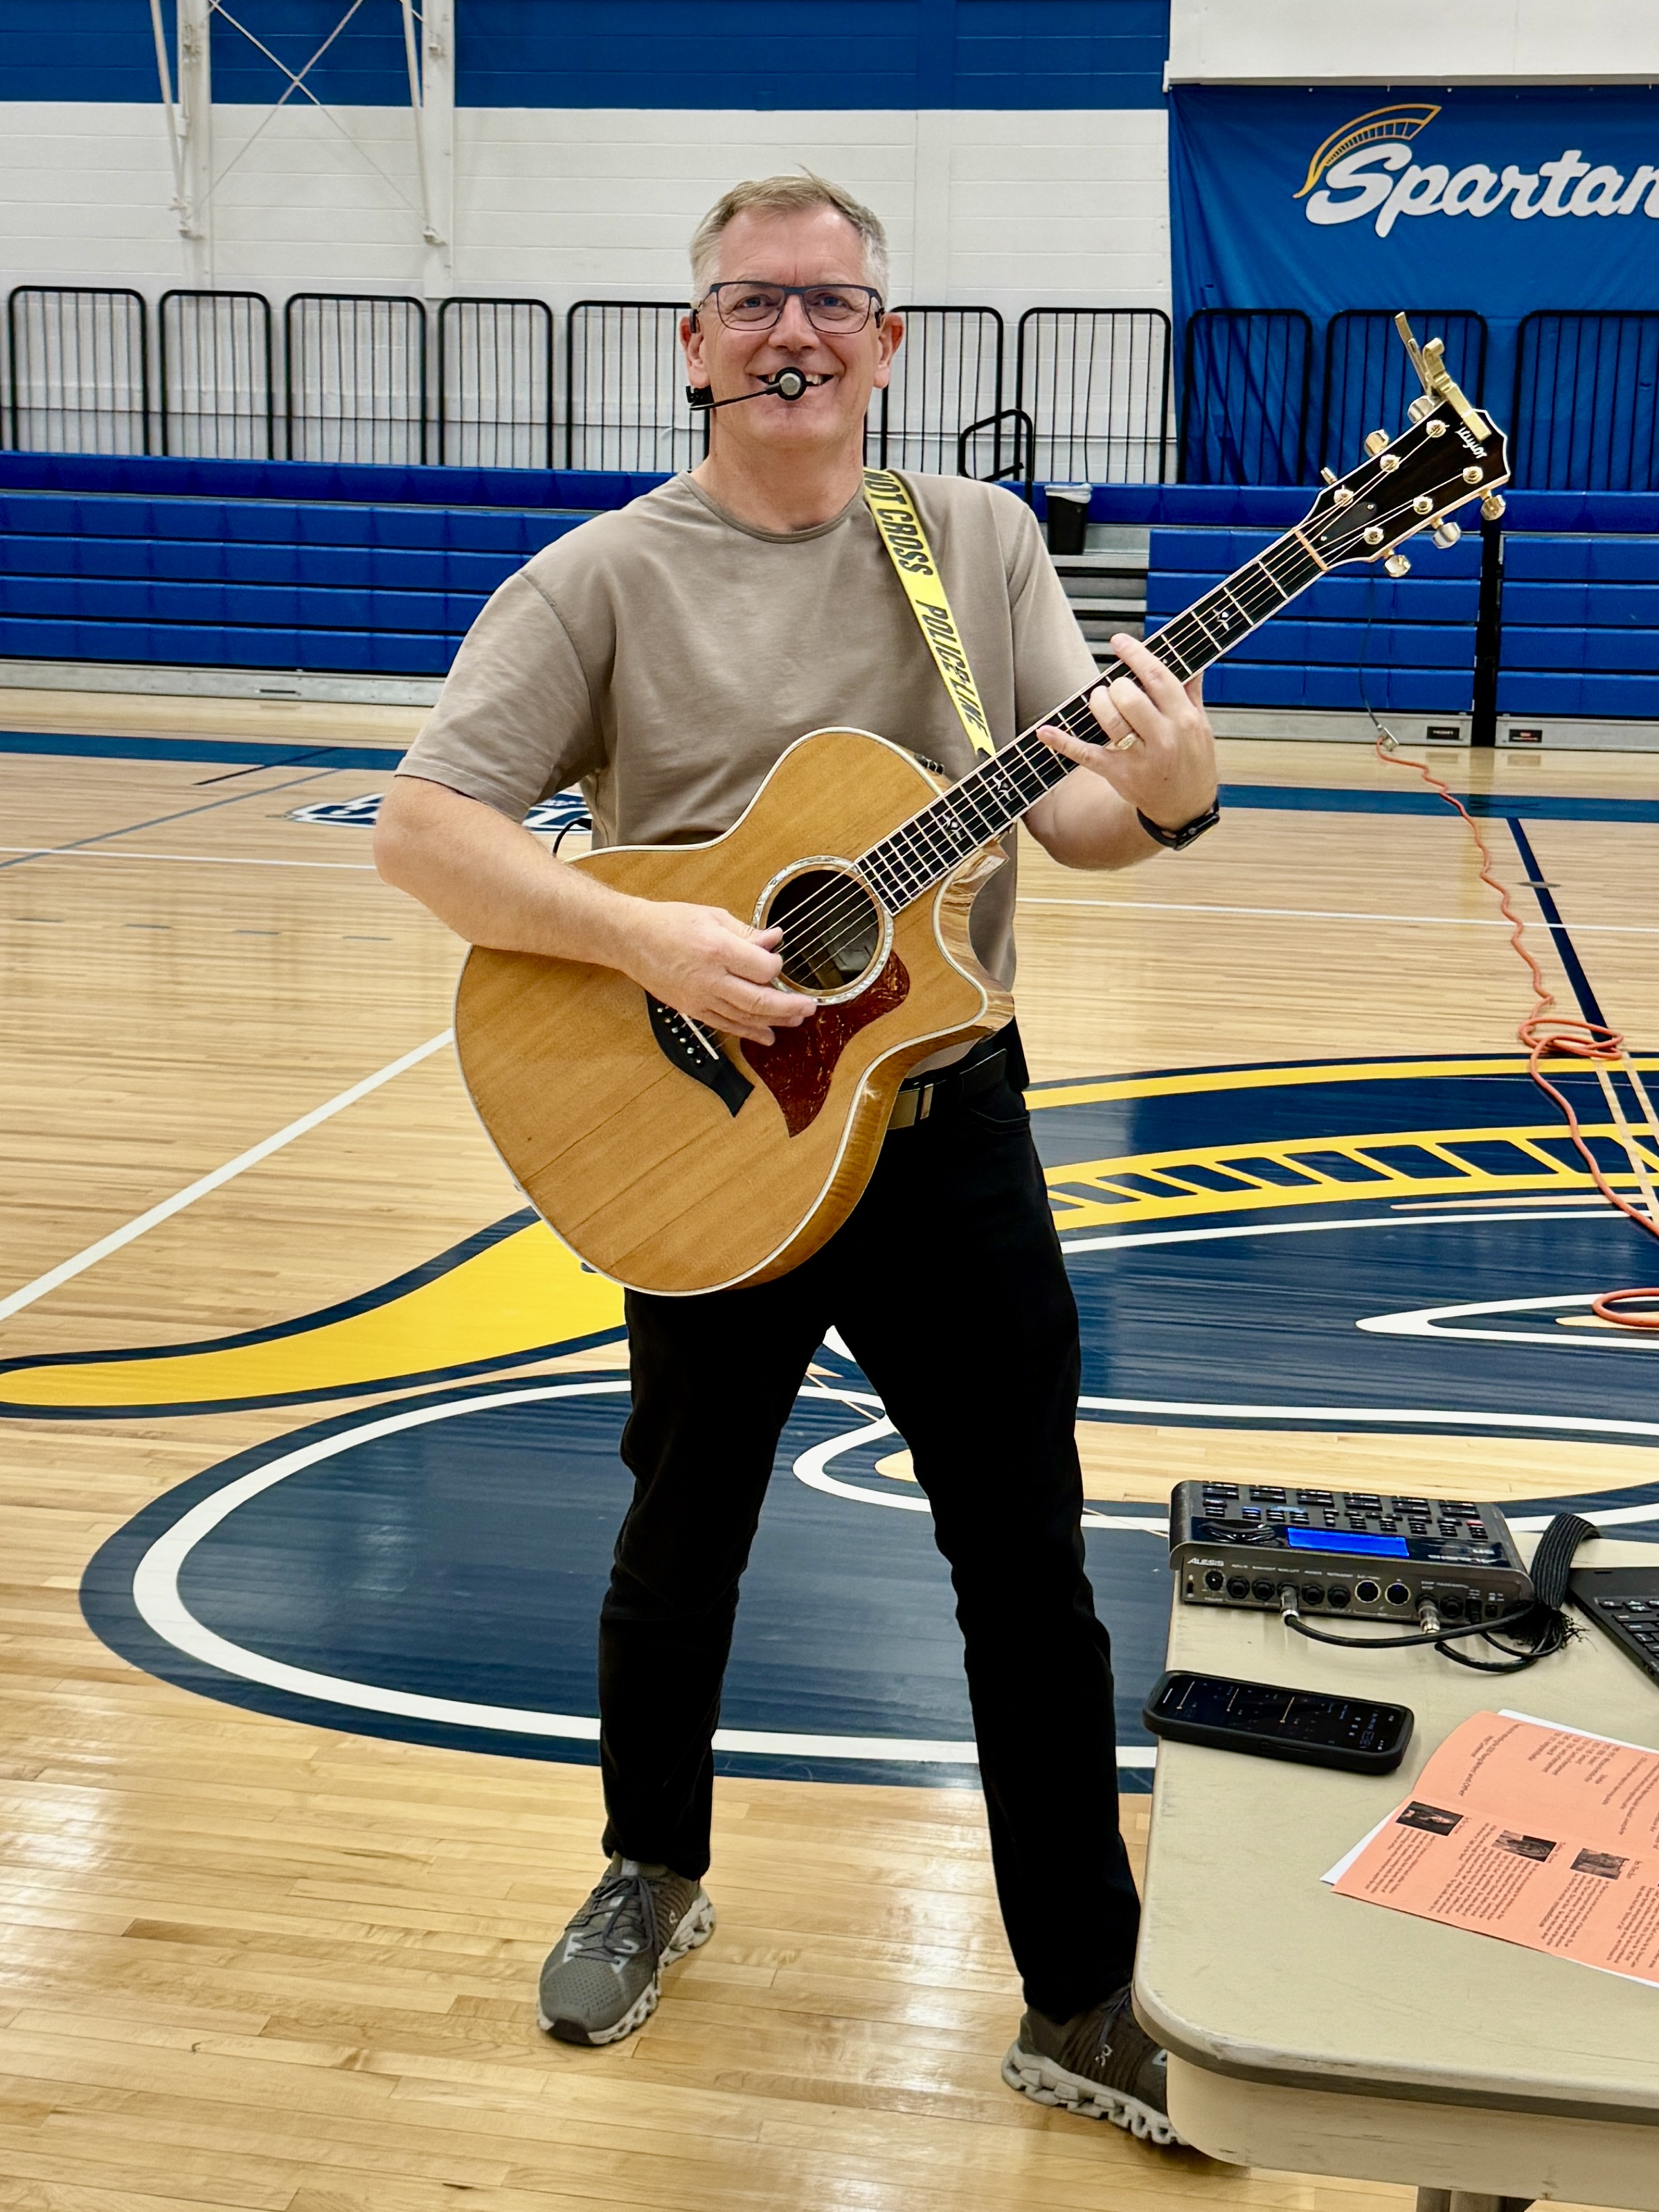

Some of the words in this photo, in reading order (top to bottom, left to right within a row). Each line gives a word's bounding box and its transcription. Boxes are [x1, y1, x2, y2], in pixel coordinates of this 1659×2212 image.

[863, 470, 907, 505] NOT
[877, 508, 933, 576] CROSS
[915, 600, 971, 683] POLICE
[949, 677, 989, 738] LINE
